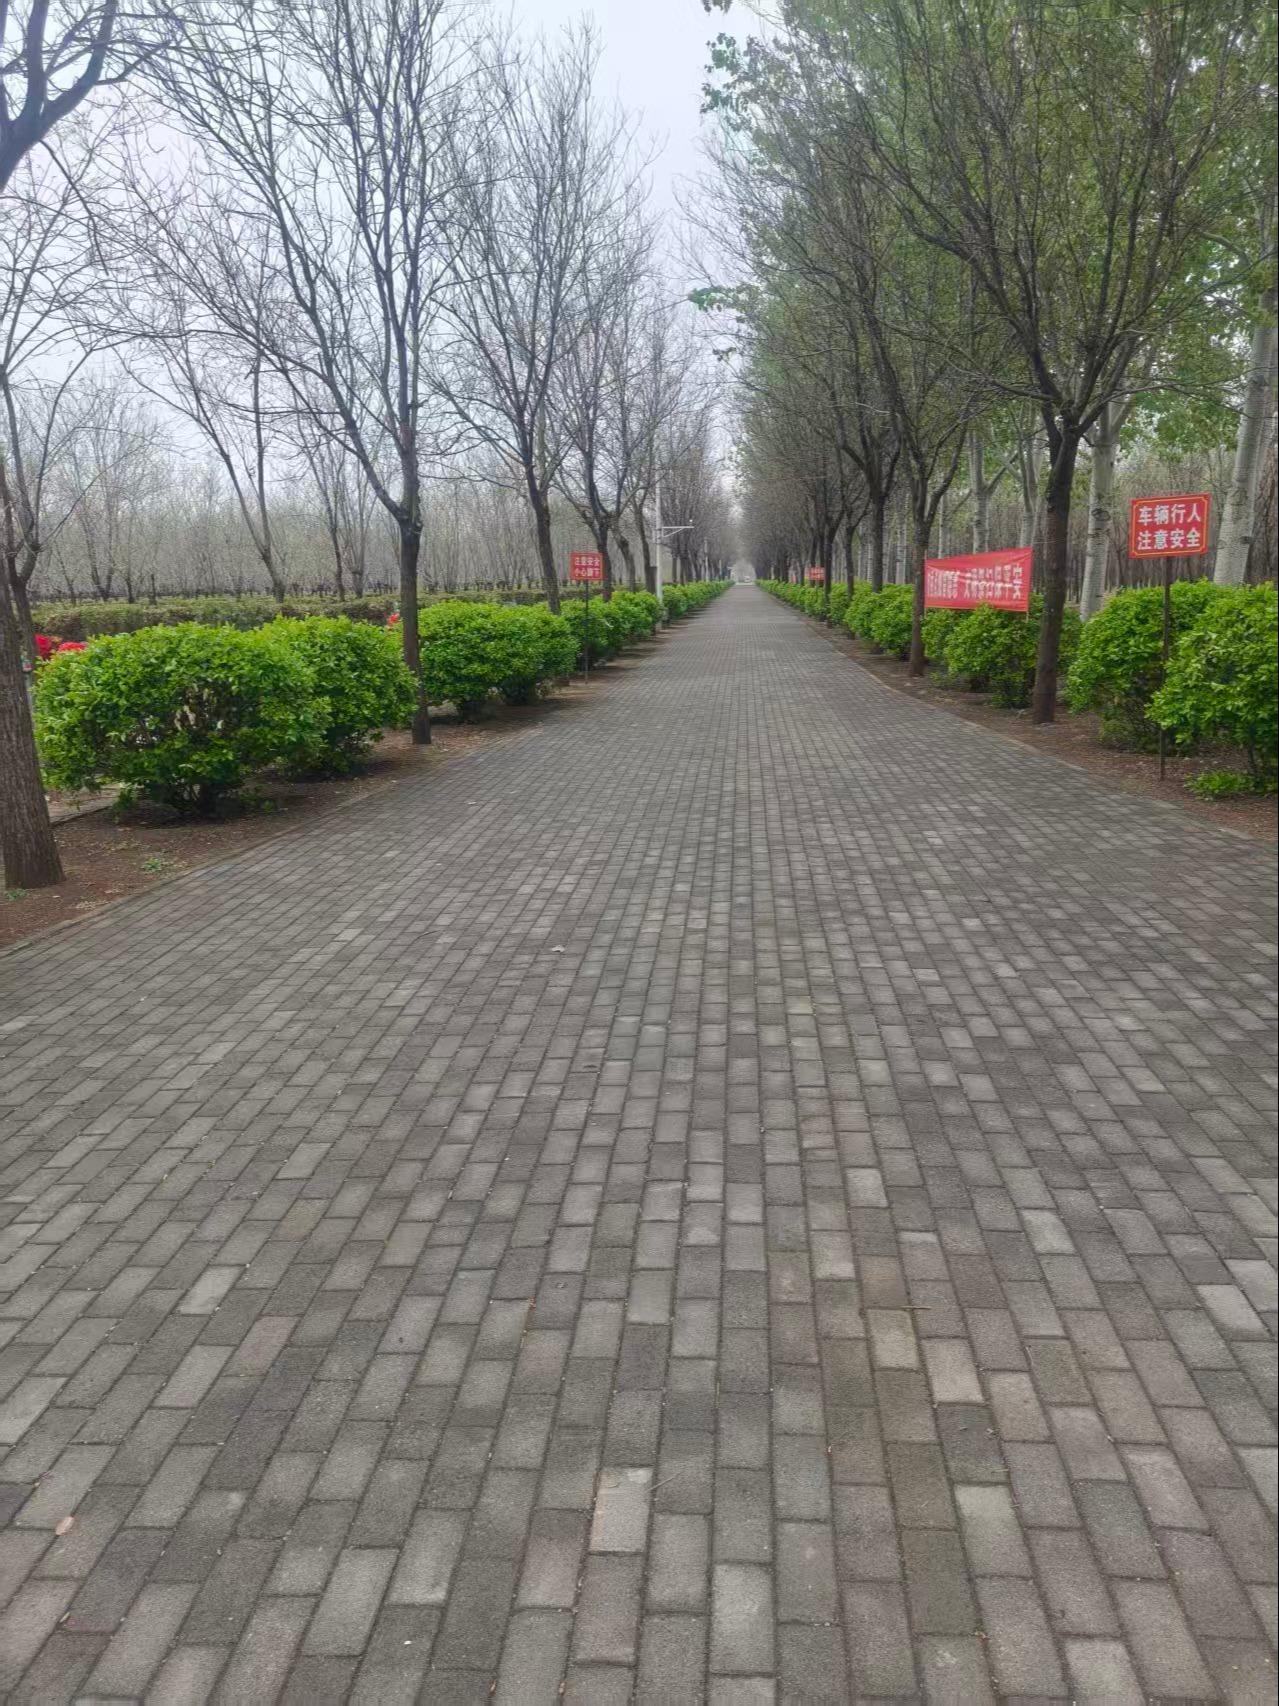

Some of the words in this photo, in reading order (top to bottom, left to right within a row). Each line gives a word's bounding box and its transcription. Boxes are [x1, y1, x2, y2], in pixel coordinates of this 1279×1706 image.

[1138, 503, 1201, 526] 车辆行人
[1137, 527, 1201, 550] 注意安全
